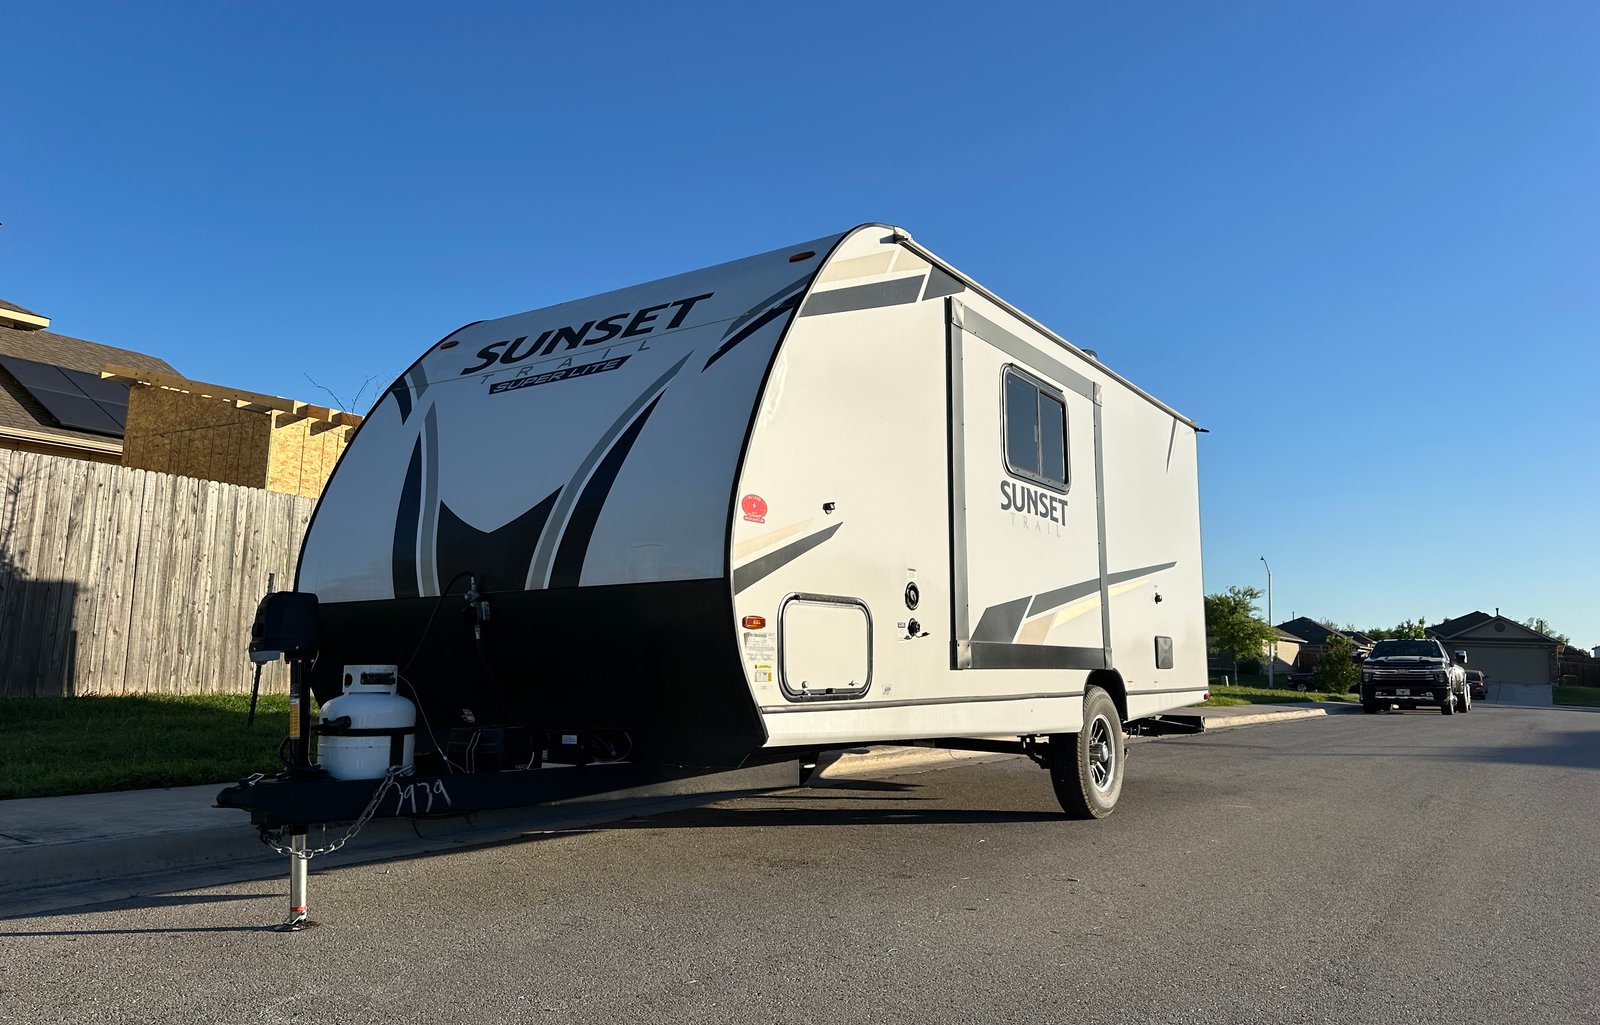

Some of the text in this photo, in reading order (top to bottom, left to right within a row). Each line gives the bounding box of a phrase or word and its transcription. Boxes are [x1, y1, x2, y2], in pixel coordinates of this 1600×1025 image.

[460, 292, 715, 376] SUNSET
[480, 341, 650, 384] TRAIL
[493, 360, 620, 392] SUPER LITE
[1000, 480, 1068, 526] SUNSET
[1010, 512, 1061, 538] TRAIL
